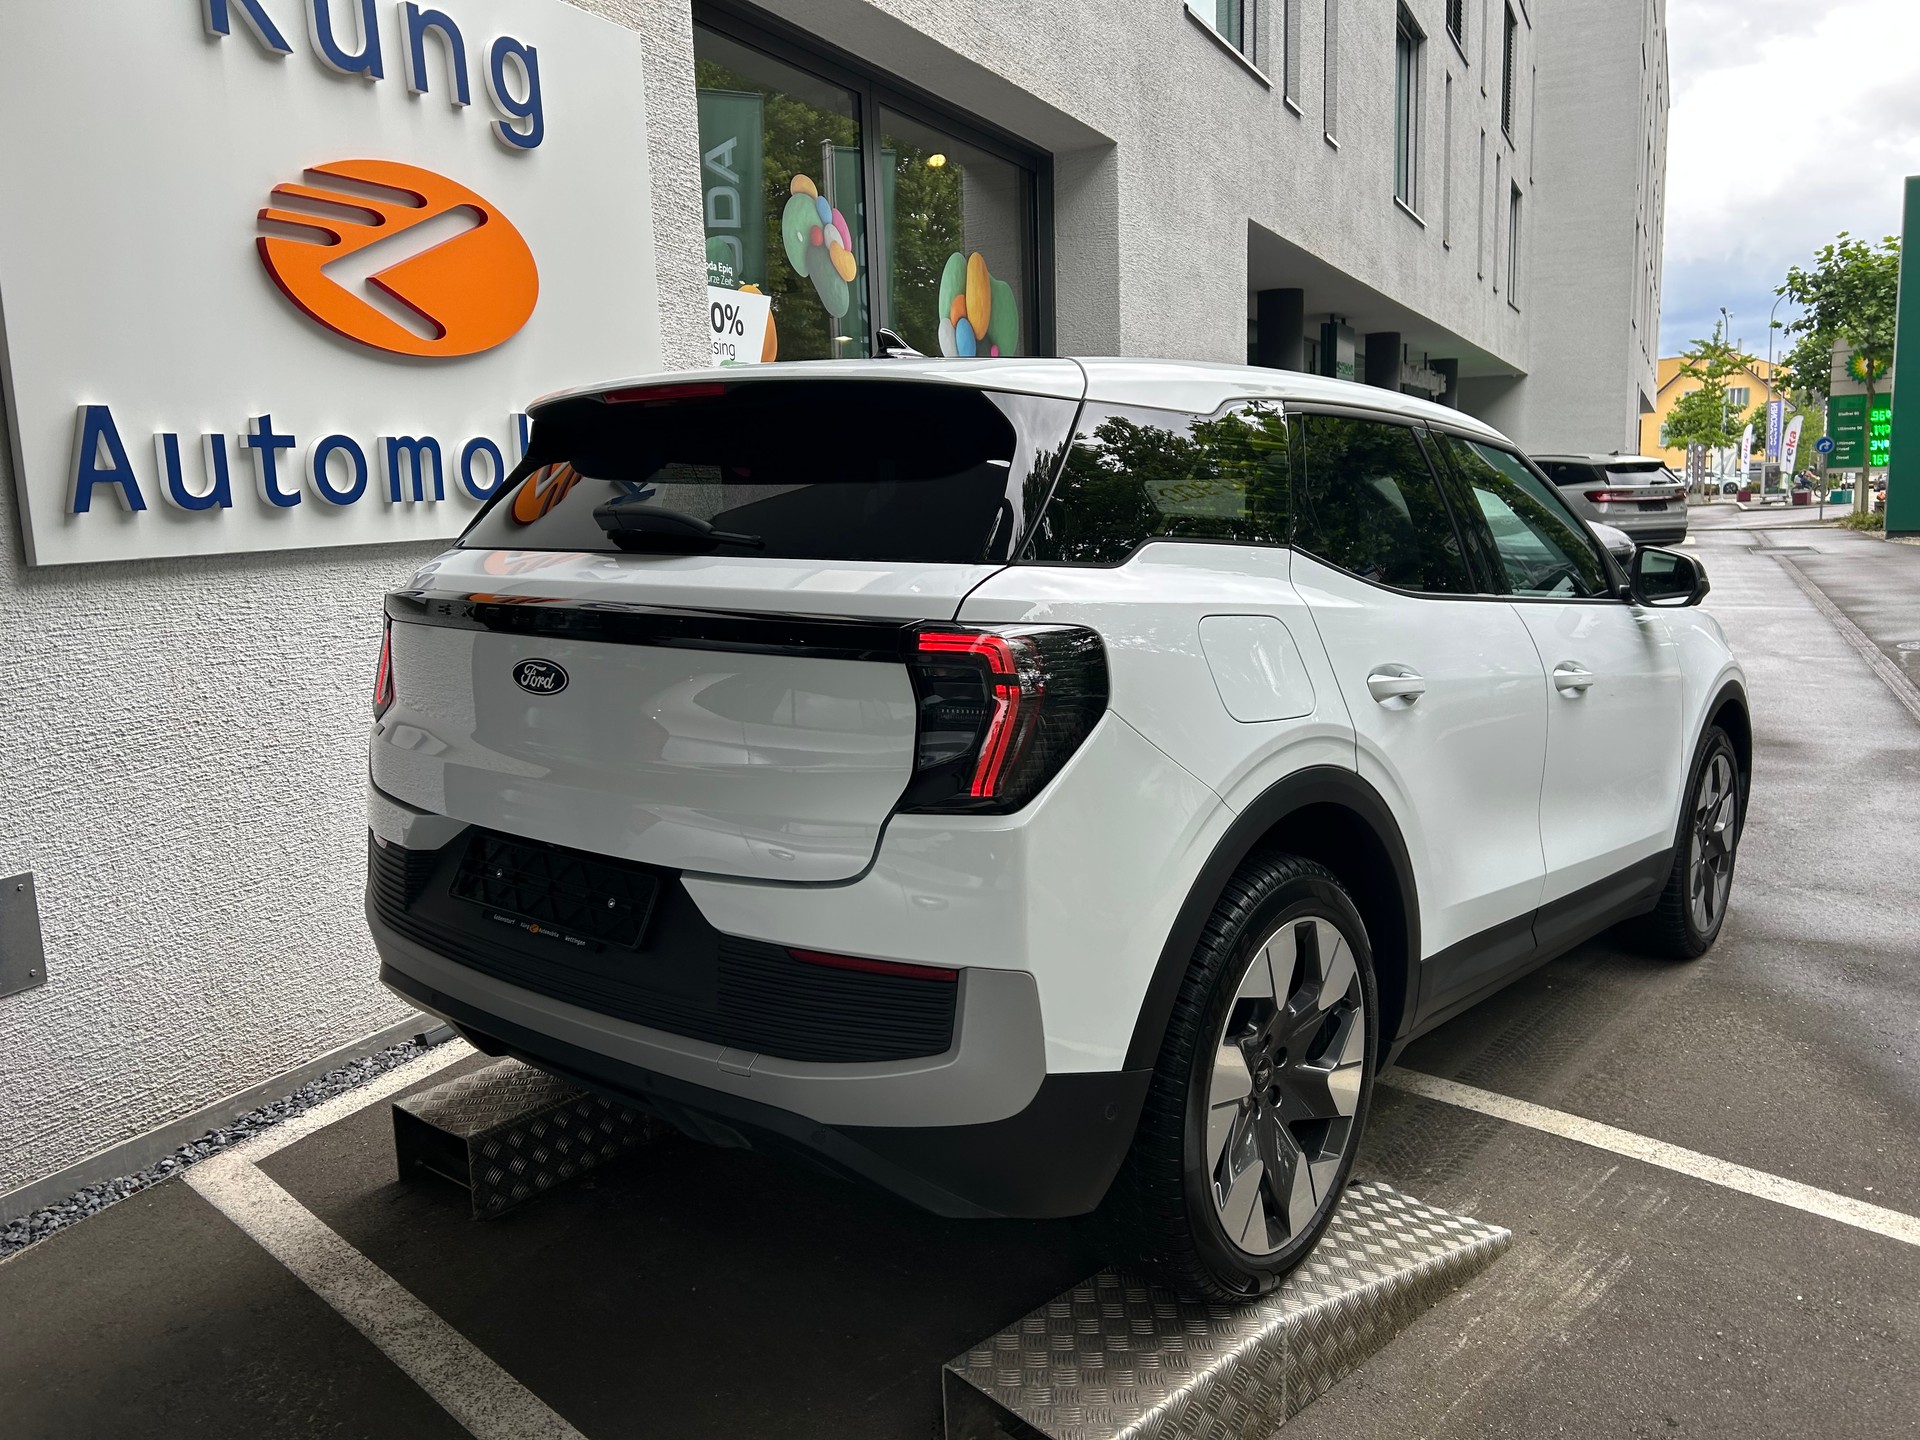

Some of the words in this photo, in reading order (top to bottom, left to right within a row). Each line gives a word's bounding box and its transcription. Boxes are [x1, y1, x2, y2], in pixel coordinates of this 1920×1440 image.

[718, 262, 733, 277] Epiq
[711, 338, 735, 362] sing
[1785, 431, 1797, 463] reka
[520, 663, 556, 689] Ford
